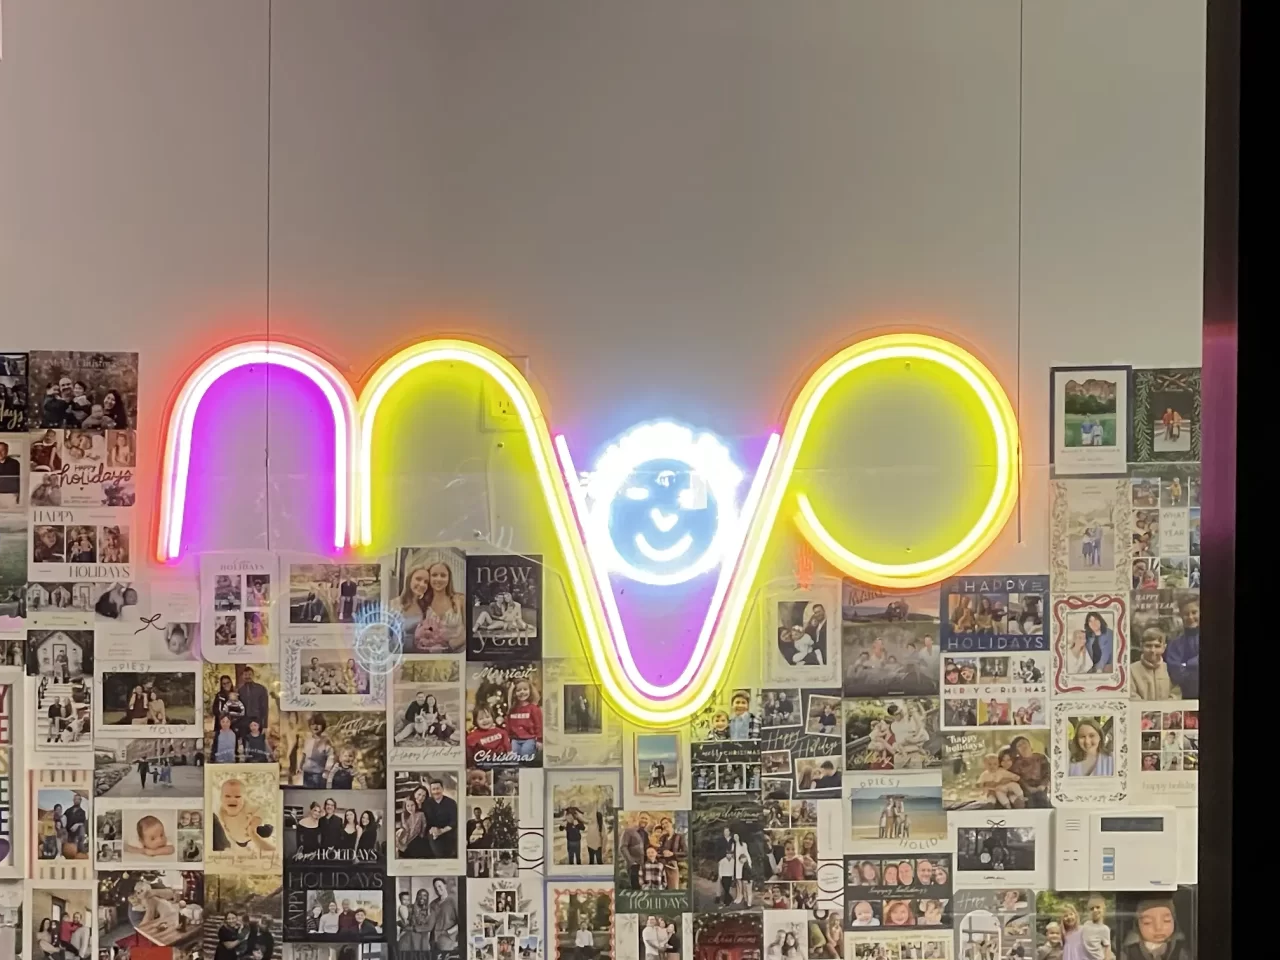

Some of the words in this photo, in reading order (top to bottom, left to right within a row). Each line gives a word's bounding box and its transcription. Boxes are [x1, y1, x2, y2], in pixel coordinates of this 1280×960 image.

[58, 463, 134, 487] holidays
[33, 510, 74, 522] HAPPY
[69, 565, 130, 578] HOLIDAYS
[477, 567, 532, 583] new
[965, 580, 1027, 593] HAPPY
[948, 637, 1043, 650] HOLIDAYS
[474, 750, 535, 763] Christmas
[317, 848, 378, 861] HOLIDAYS
[288, 872, 383, 889] HOLIDAYS
[629, 894, 688, 910] HOLIDAYS
